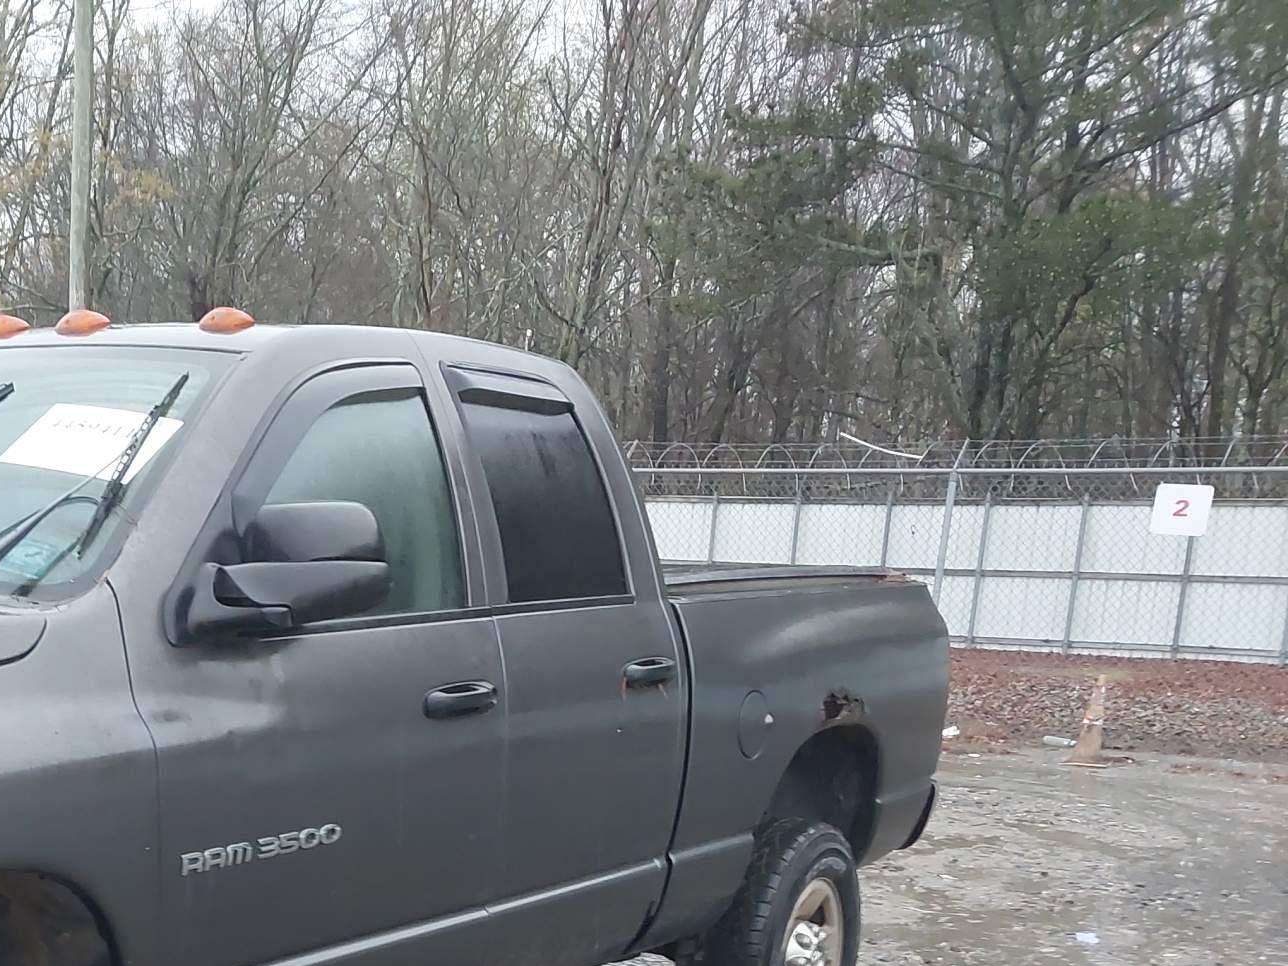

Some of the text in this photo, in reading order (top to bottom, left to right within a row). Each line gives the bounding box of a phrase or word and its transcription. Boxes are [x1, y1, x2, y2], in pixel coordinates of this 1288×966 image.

[1173, 499, 1190, 517] 2
[180, 823, 342, 876] RAM 3500
